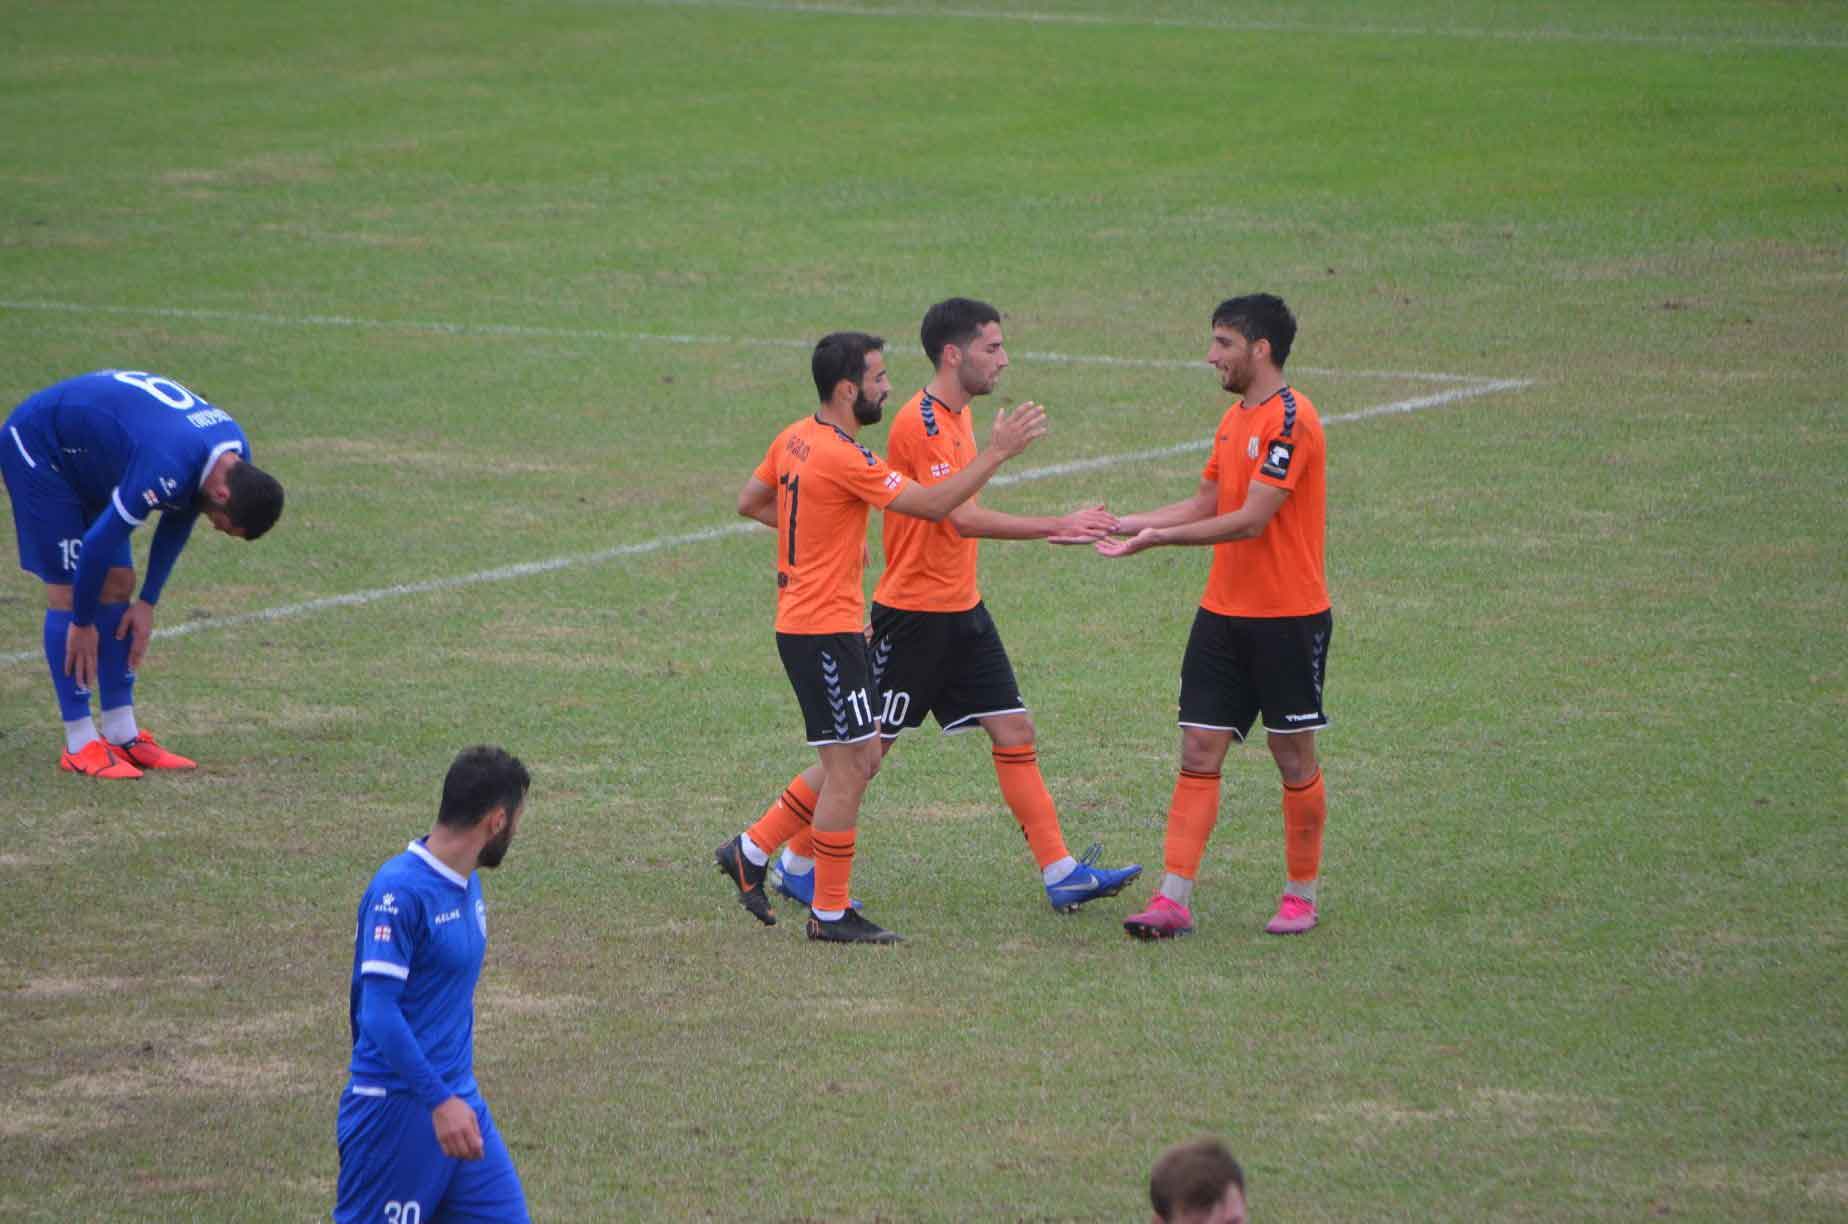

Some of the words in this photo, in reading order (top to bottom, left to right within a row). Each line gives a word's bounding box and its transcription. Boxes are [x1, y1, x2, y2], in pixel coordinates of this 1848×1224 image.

[780, 472, 799, 566] 11
[847, 688, 872, 726] 11
[881, 689, 911, 726] 10
[384, 1200, 420, 1224] 30
